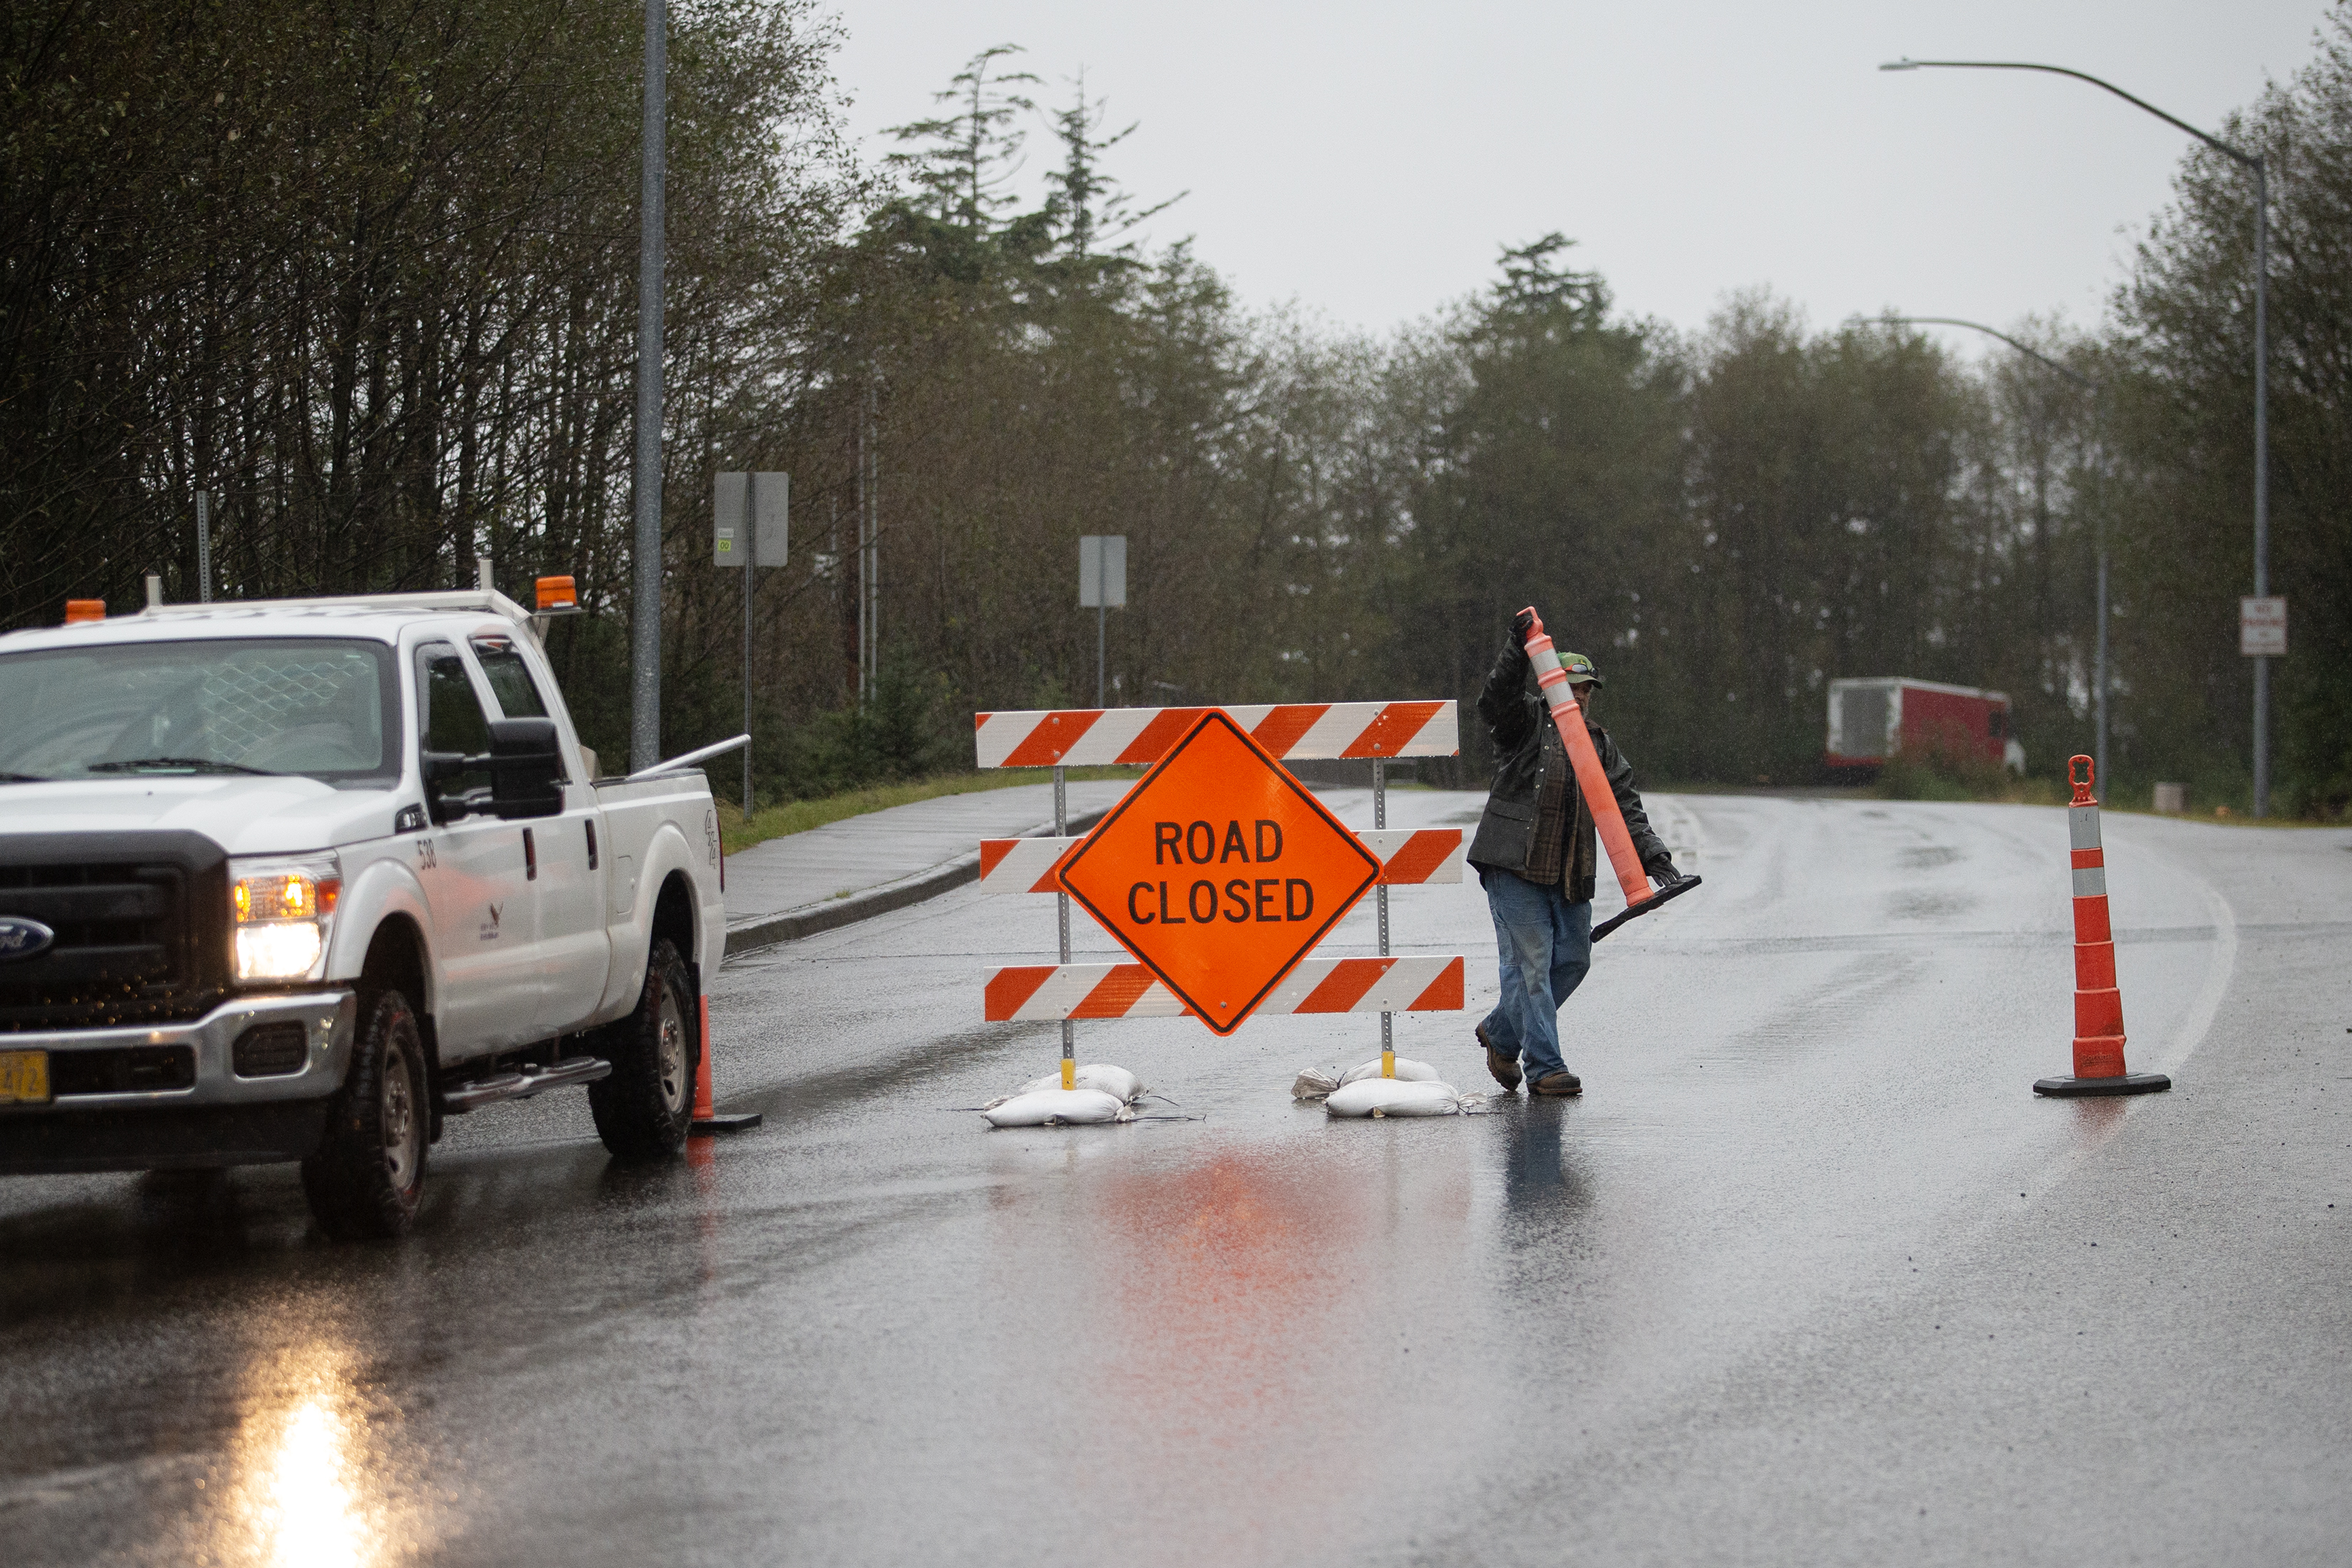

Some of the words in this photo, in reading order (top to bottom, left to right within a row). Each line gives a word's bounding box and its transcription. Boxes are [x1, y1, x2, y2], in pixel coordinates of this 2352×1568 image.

[417, 838, 437, 870] 538
[1155, 820, 1283, 865] ROAD
[1128, 878, 1314, 924] CLOSED
